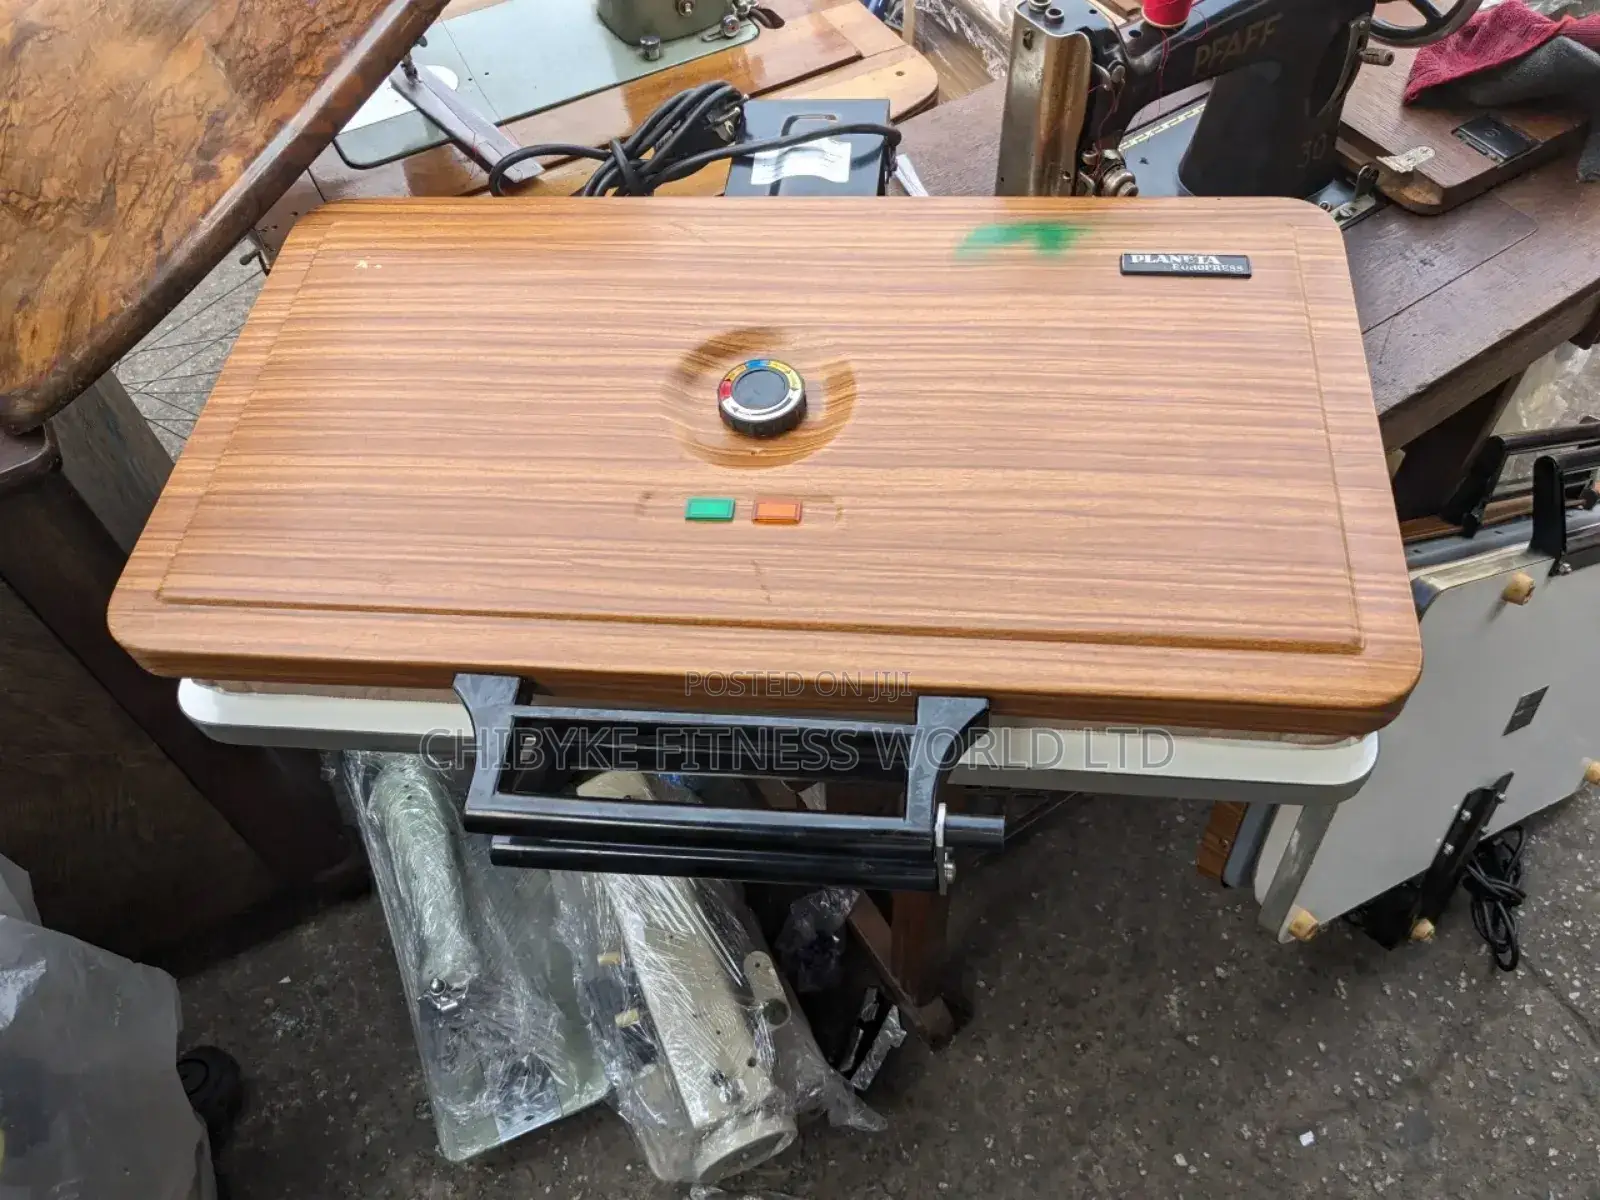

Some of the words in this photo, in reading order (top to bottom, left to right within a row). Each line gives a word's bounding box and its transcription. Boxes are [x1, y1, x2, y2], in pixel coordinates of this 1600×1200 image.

[1192, 11, 1284, 77] PFAFF
[1296, 133, 1328, 168] 30
[1130, 254, 1222, 265] PLANETA
